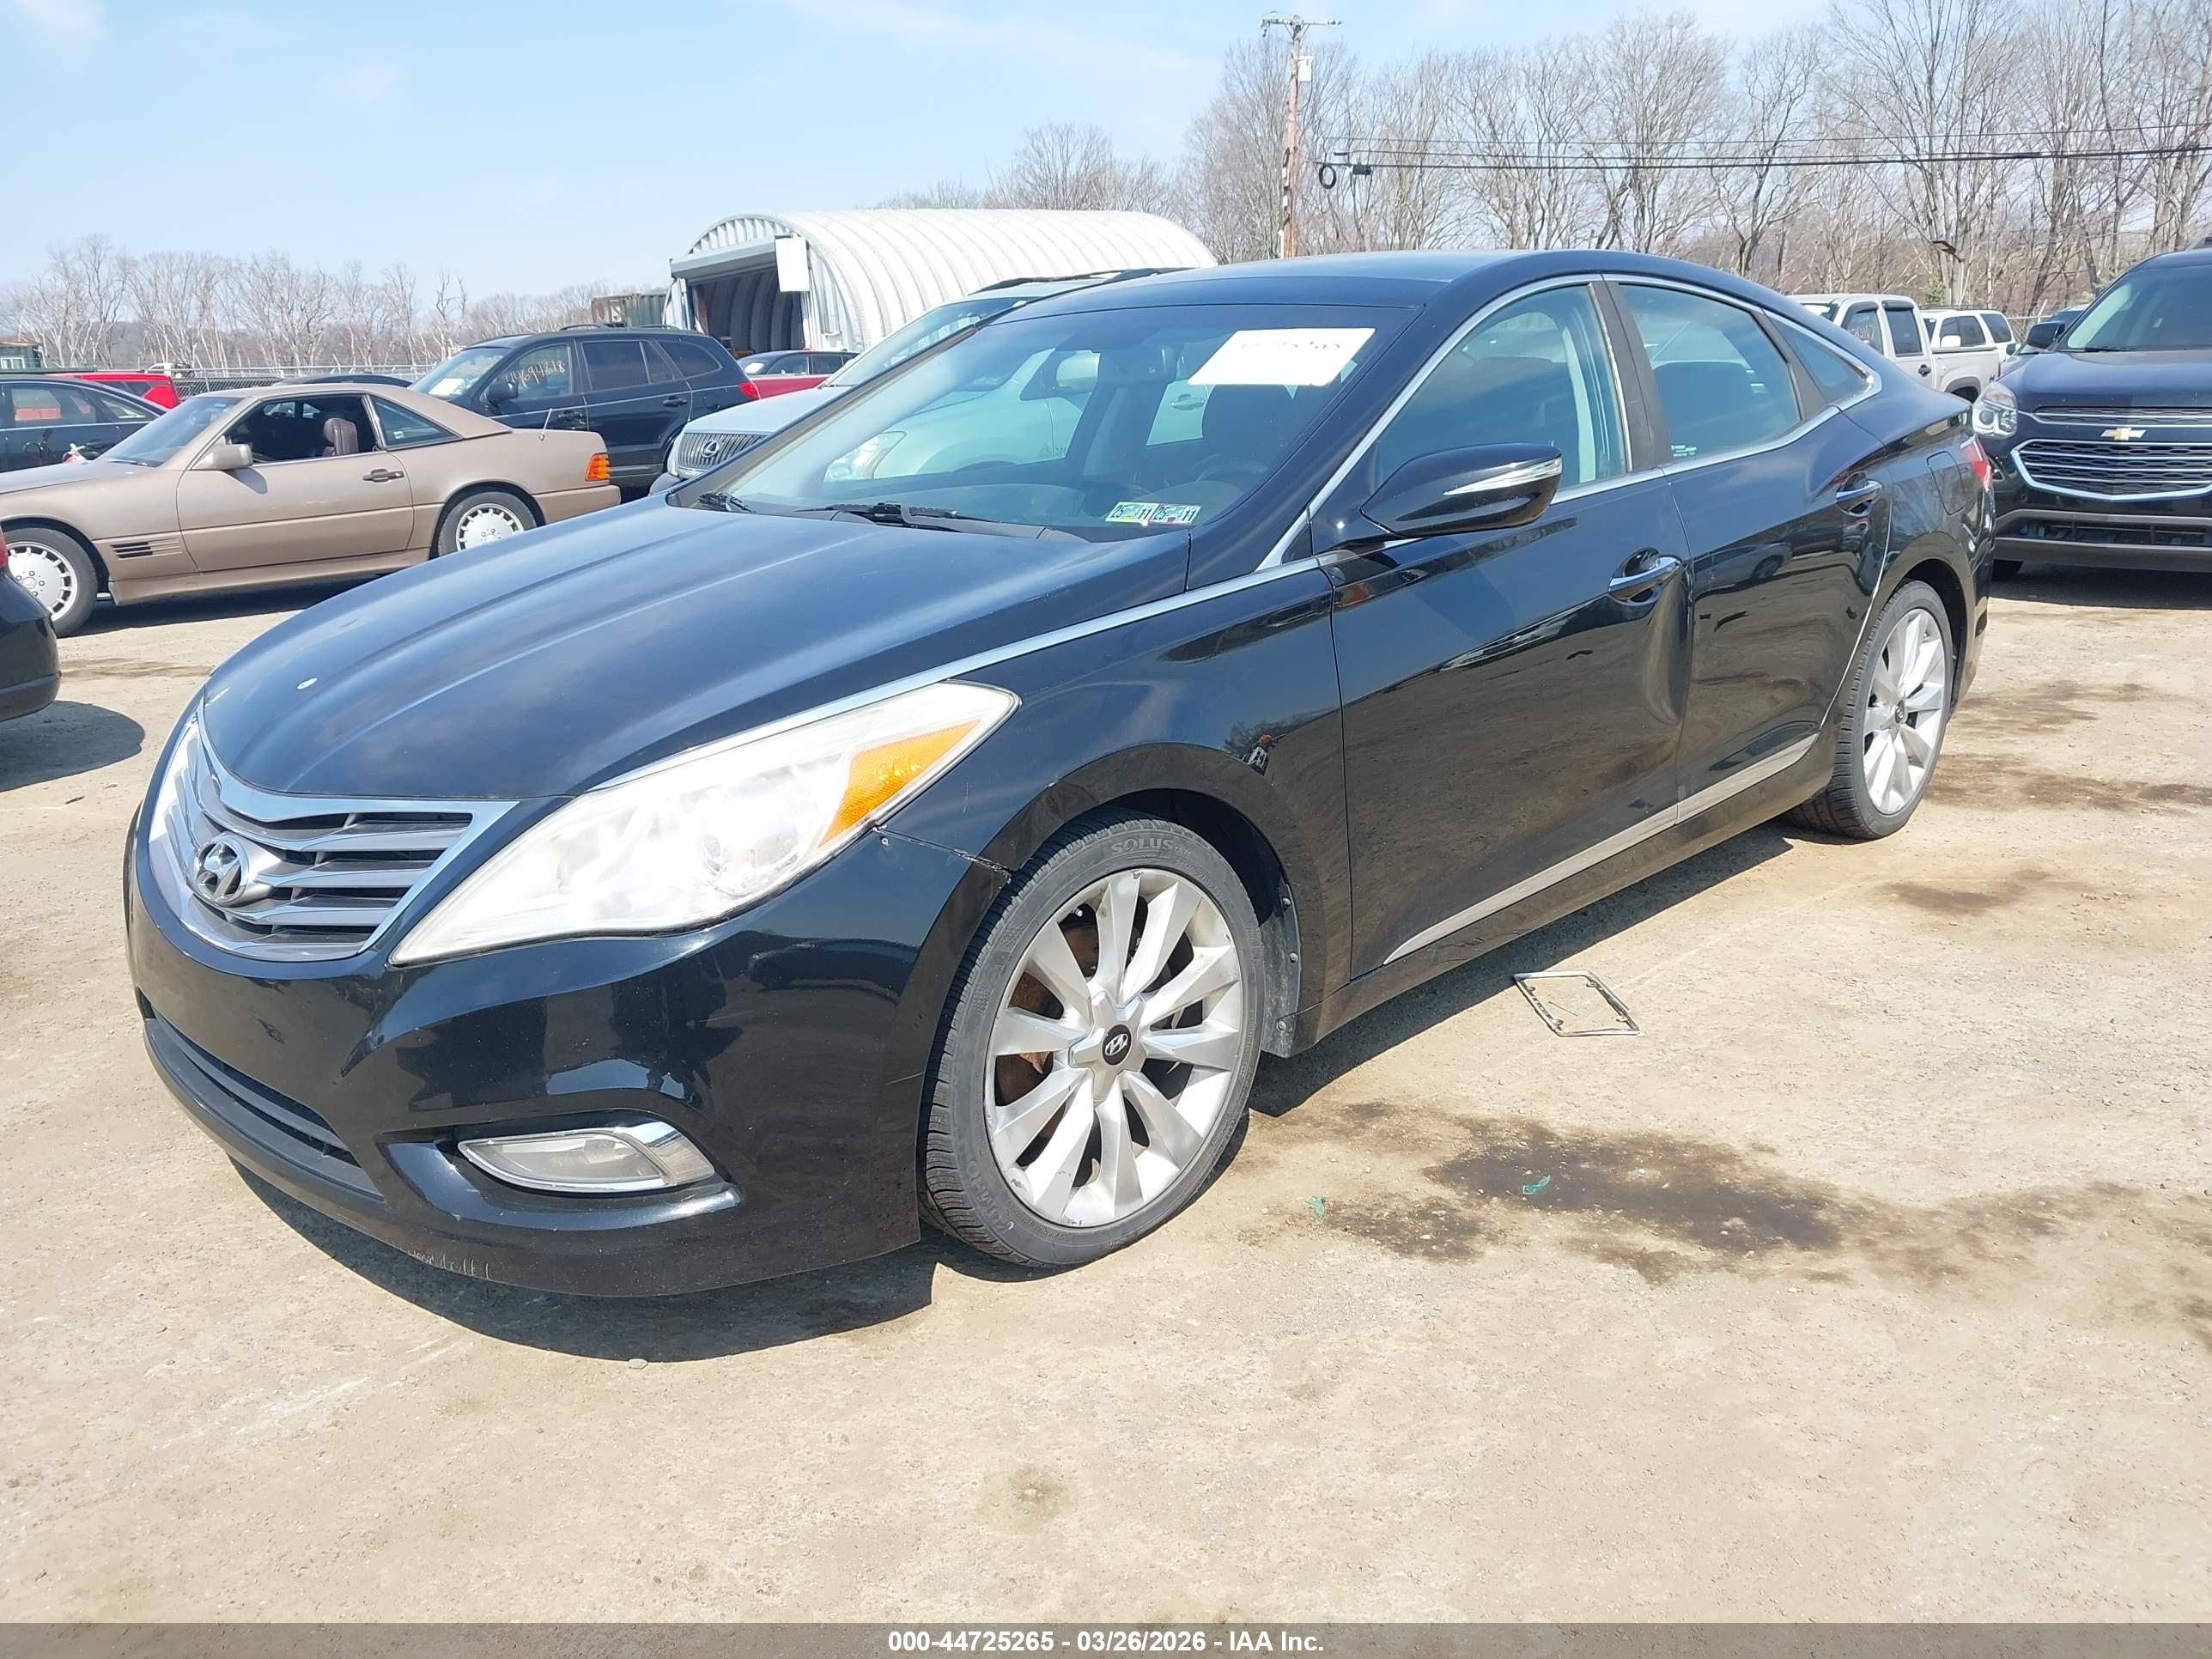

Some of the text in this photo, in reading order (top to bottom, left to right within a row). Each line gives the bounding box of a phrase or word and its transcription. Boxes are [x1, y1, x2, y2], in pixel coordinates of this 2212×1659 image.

[1138, 508, 1152, 520] 11
[1182, 510, 1197, 521] 11
[1111, 838, 1174, 855] SOLUS
